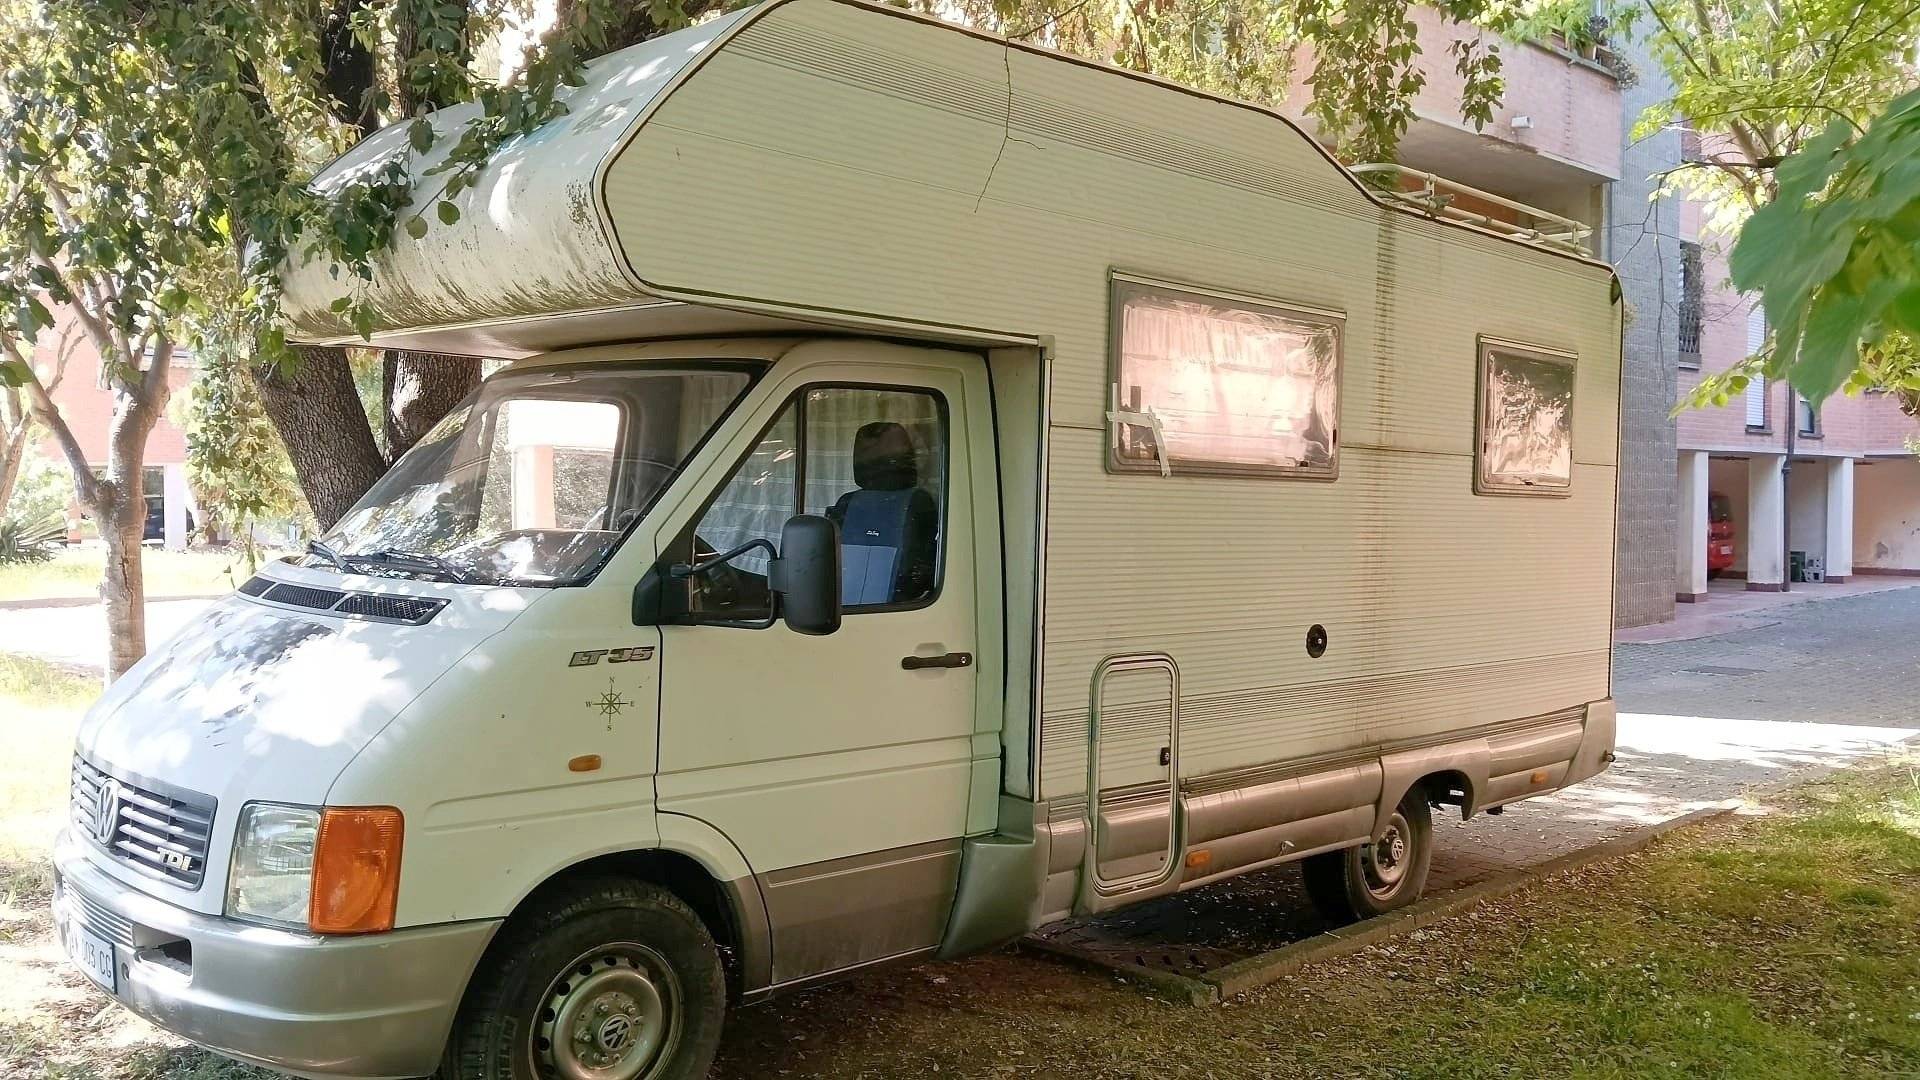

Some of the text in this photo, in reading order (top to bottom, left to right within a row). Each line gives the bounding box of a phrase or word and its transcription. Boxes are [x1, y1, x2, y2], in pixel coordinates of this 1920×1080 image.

[608, 645, 656, 664] 35
[609, 676, 615, 684] N
[585, 700, 593, 708] W
[157, 846, 193, 871] TDI
